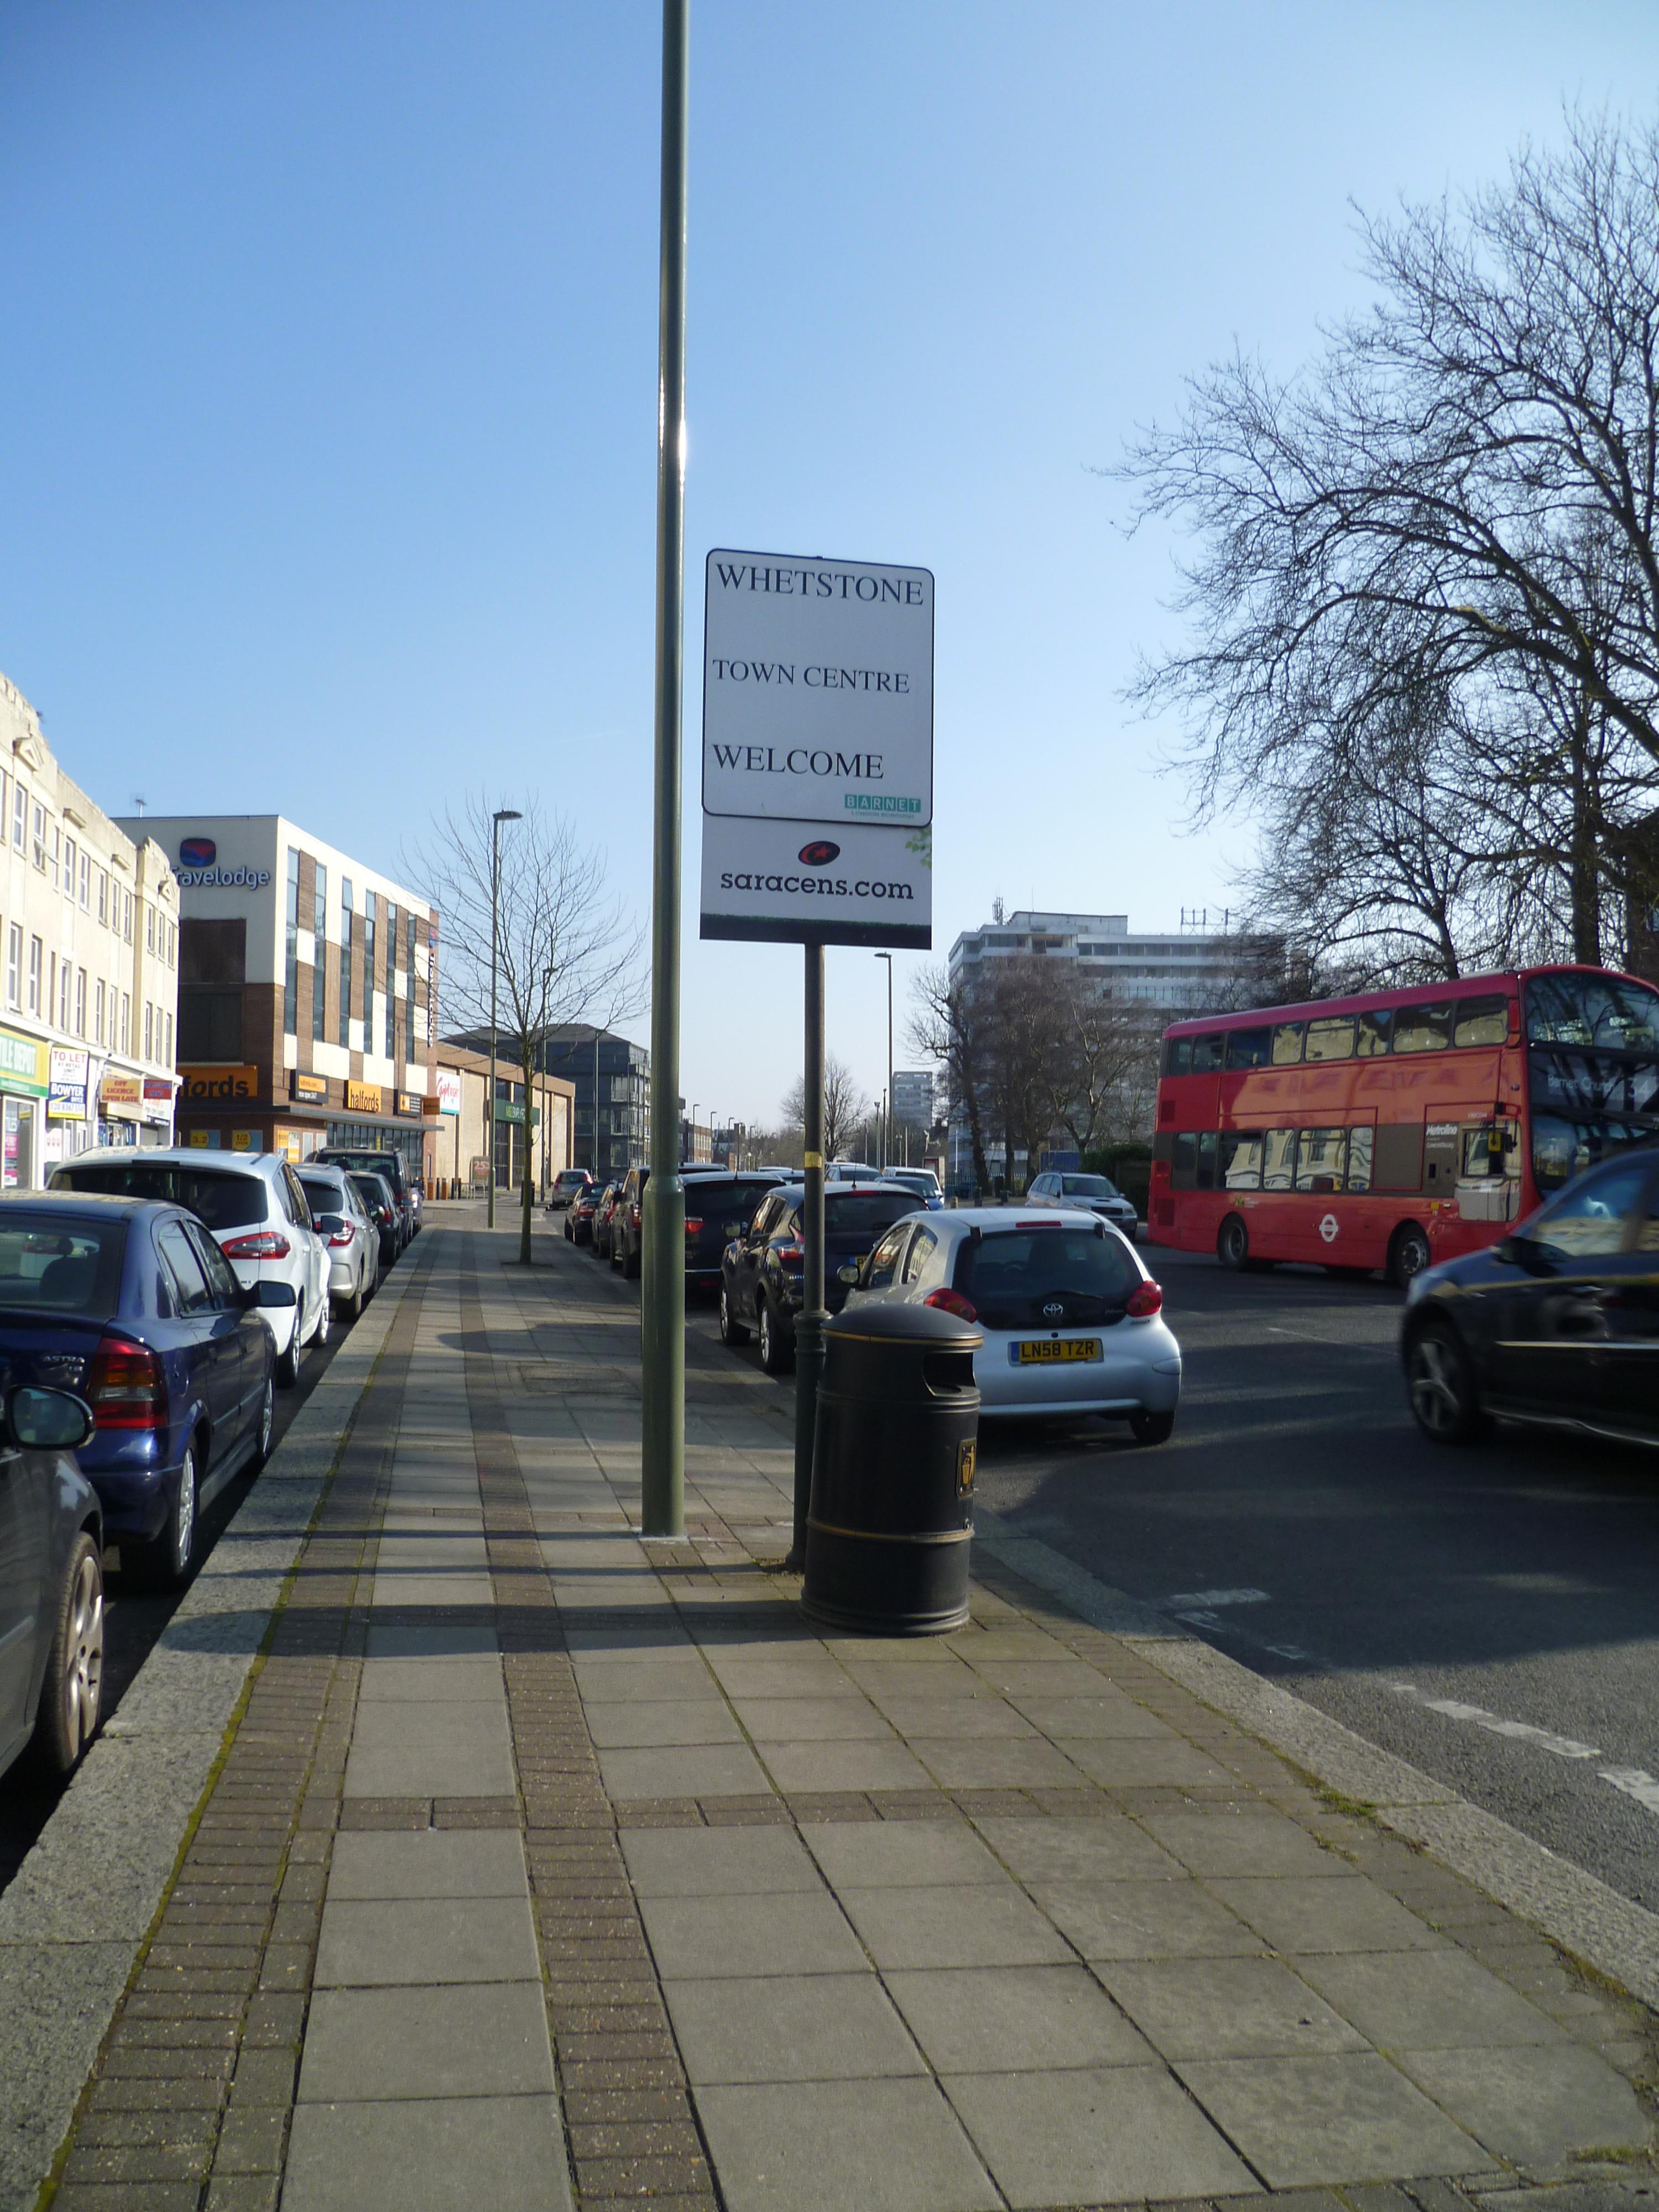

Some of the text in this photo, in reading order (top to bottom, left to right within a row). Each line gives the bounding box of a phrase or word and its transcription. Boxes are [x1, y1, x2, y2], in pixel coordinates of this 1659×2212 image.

[716, 564, 924, 606] WHETSTONE
[712, 659, 910, 694] TOWN CENTRE
[713, 744, 884, 779] WELCOME
[845, 795, 921, 813] BARNET
[721, 872, 914, 900] saracens.com
[53, 1051, 86, 1063] TO LET
[51, 1082, 84, 1098] BOWYER
[183, 1075, 249, 1097] fords
[350, 1088, 379, 1111] halfords
[1426, 1124, 1458, 1135] Metroline
[1021, 1341, 1094, 1358] LN58 TZR
